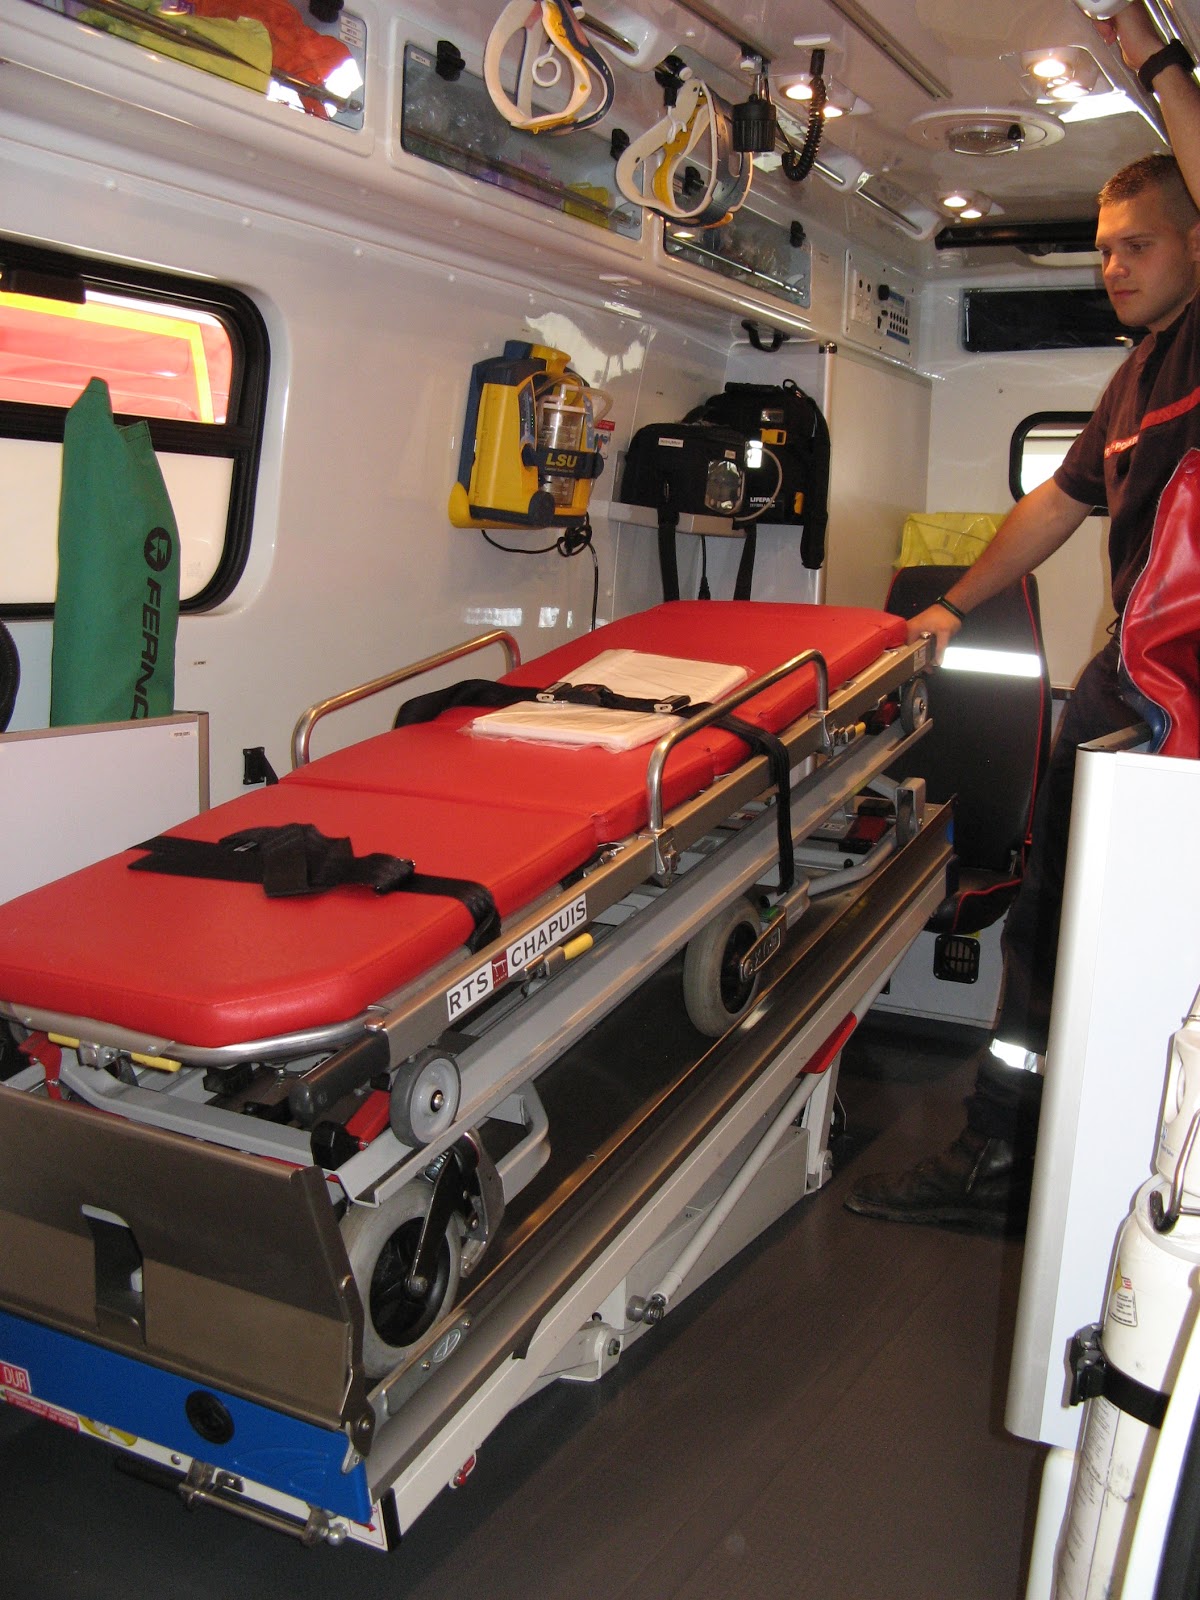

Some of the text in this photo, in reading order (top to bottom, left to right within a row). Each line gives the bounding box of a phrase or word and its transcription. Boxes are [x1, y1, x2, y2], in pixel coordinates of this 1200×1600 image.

[546, 453, 577, 467] LSU
[449, 900, 586, 1015] RTS CHAPUIS
[3, 1366, 28, 1390] DUR
